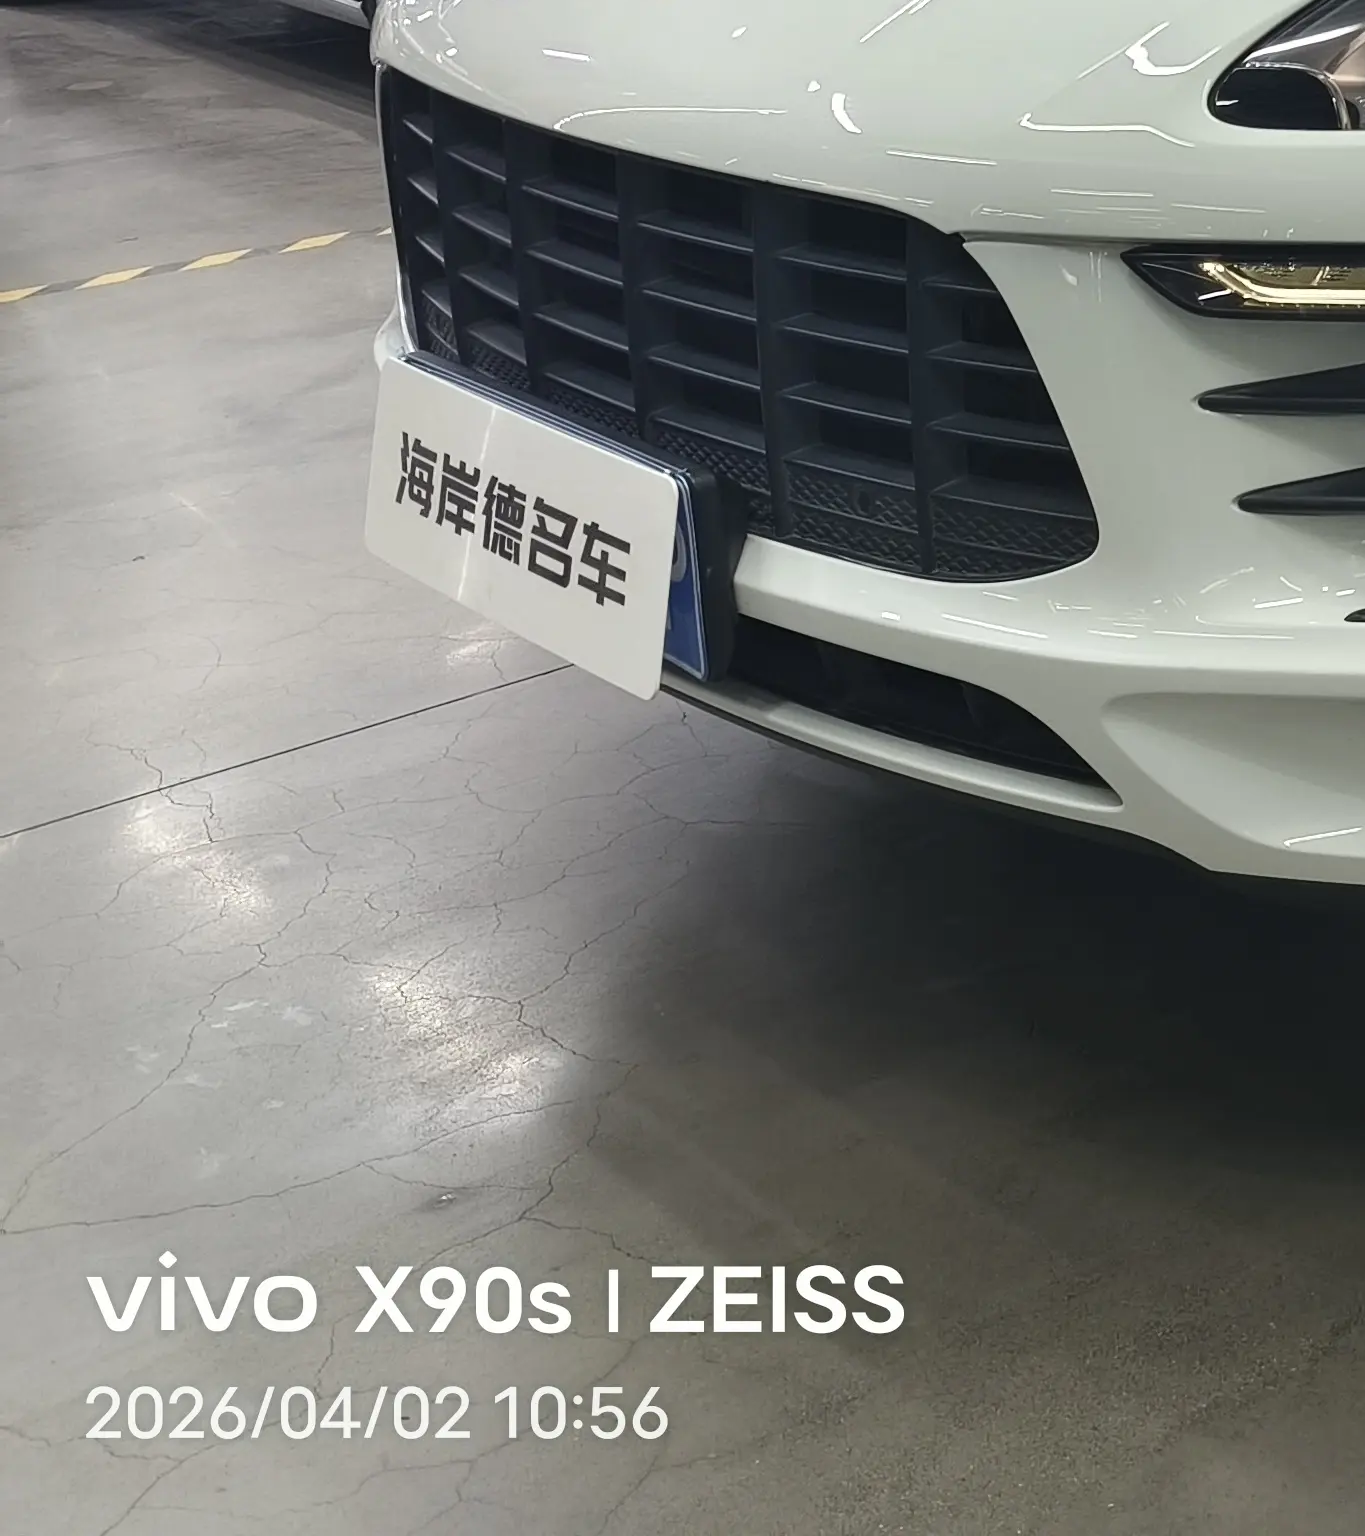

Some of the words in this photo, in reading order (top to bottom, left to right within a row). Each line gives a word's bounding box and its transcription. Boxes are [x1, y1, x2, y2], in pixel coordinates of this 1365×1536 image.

[395, 431, 632, 607] 海岸德名车
